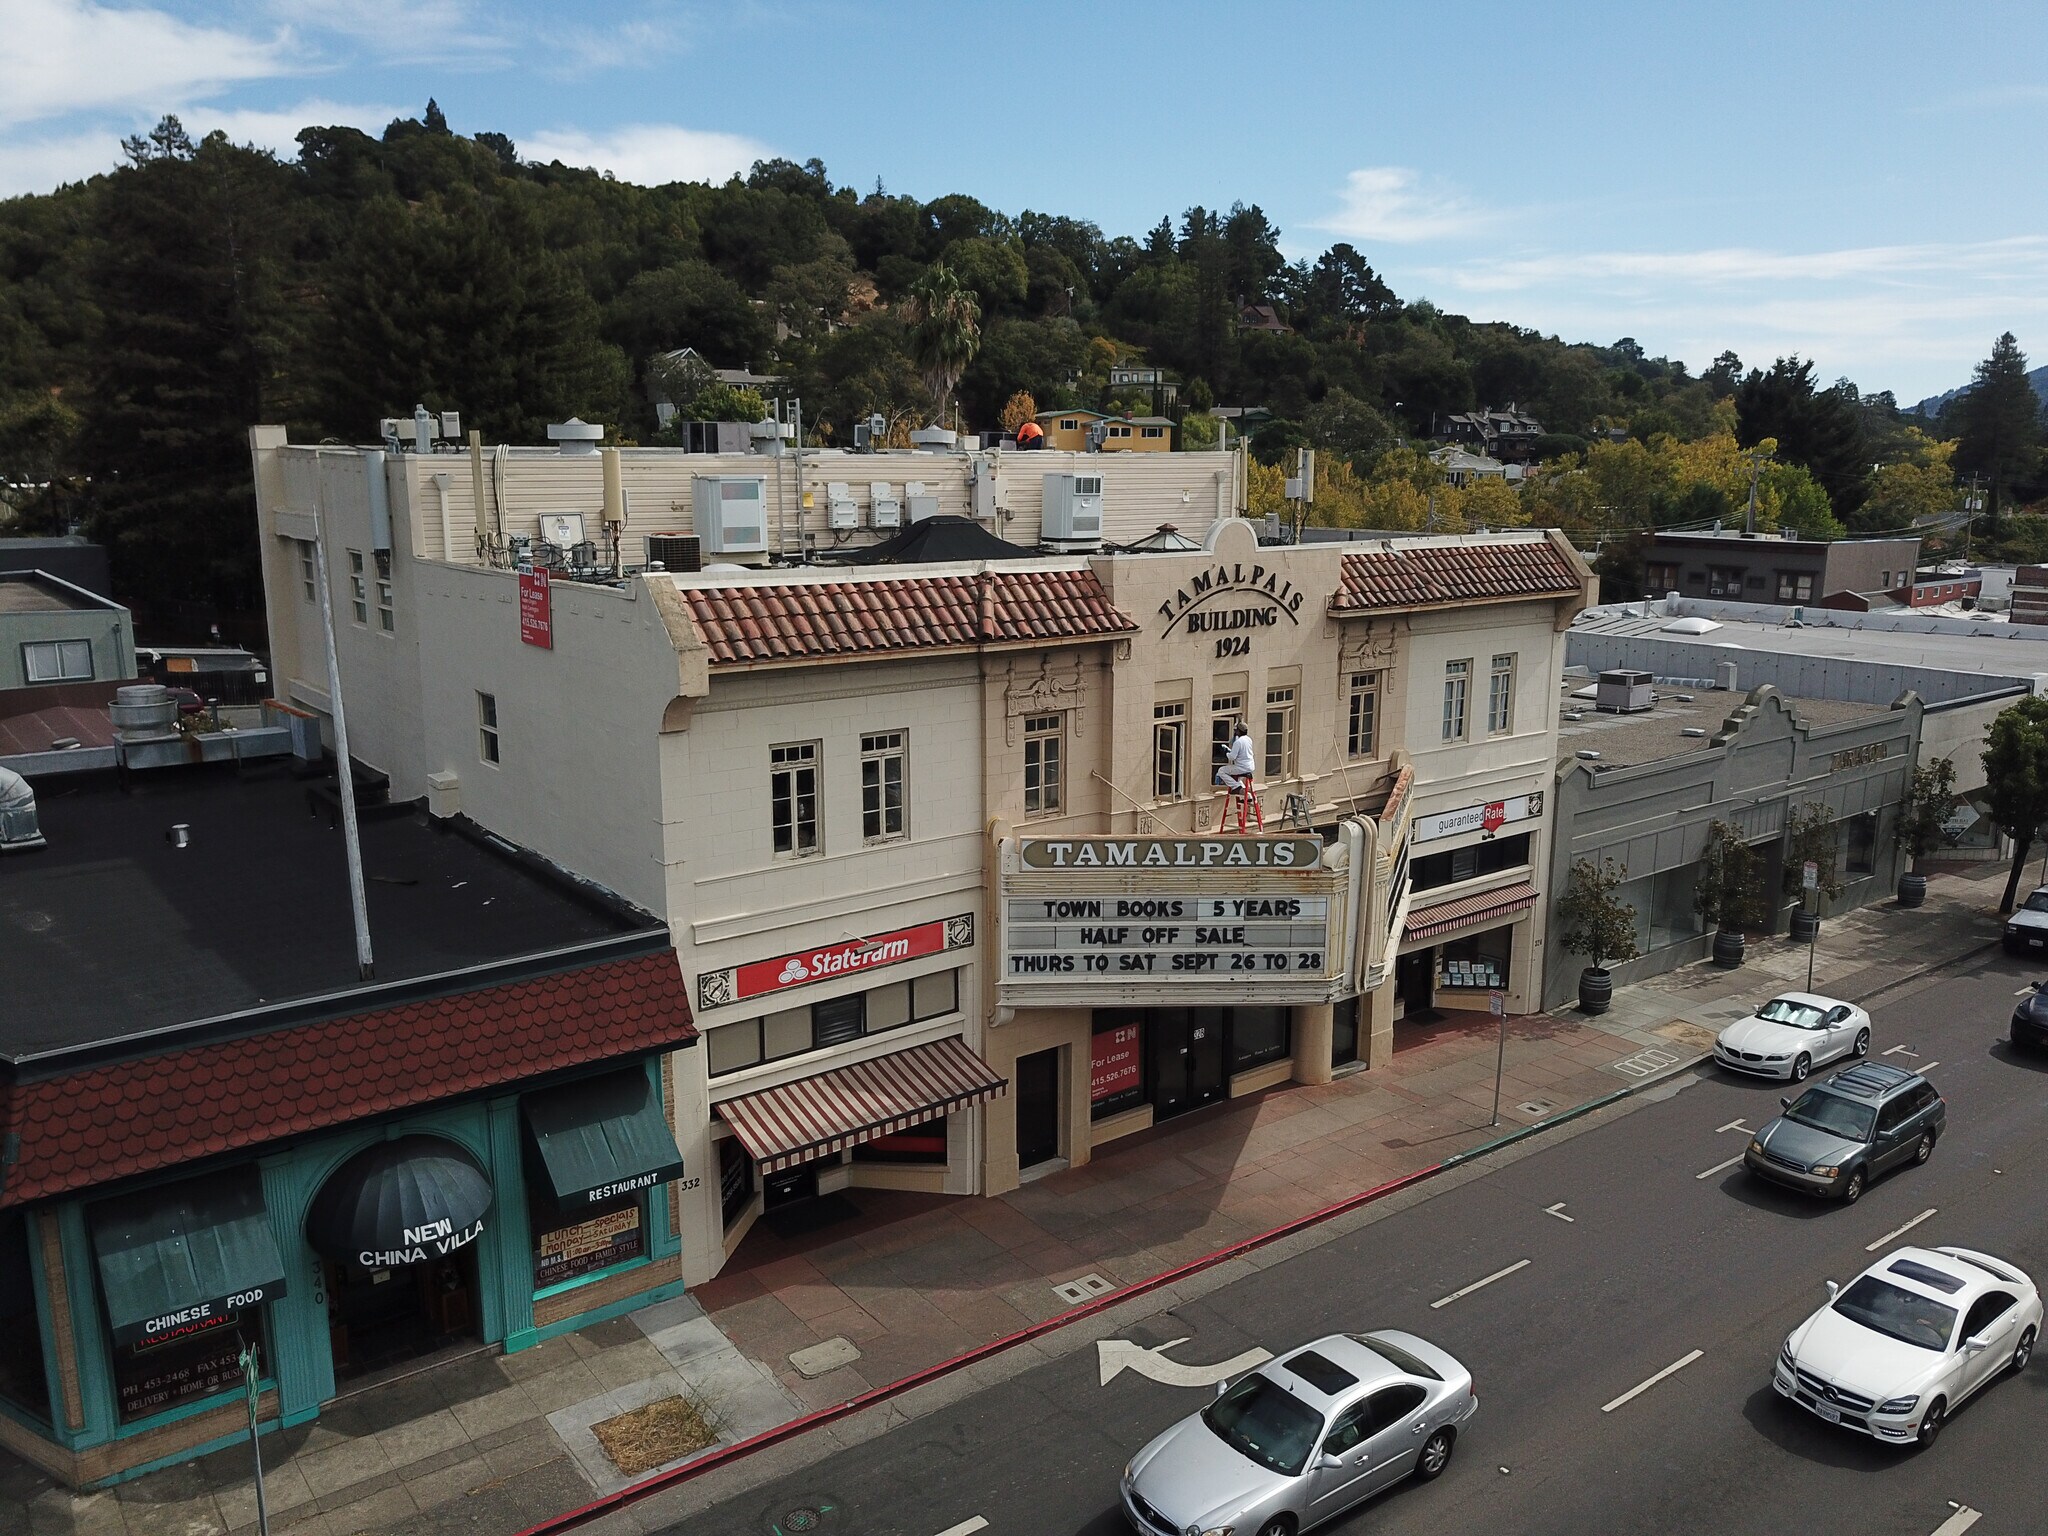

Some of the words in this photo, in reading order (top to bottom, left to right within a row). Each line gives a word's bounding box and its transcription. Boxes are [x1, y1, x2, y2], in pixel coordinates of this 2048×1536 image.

[1159, 563, 1304, 621] TAMALPAIS
[1187, 606, 1277, 633] BUILDING
[1215, 636, 1250, 658] 1924
[1438, 811, 1484, 834] guaranteed
[1485, 807, 1504, 821] Rate
[1046, 842, 1296, 867] TAMALPAIS
[1043, 900, 1101, 918] TOWN
[1116, 900, 1183, 917] BOOKS
[1213, 900, 1225, 917] 5
[1232, 899, 1301, 917] YEARS
[1080, 927, 1128, 944] HALF
[1142, 927, 1179, 944] OFF
[1195, 926, 1244, 944] SALE
[1012, 955, 1075, 972] THURS
[1083, 955, 1109, 971] TO
[1119, 954, 1156, 970] SAT
[1172, 953, 1219, 970] SEPT
[1231, 953, 1256, 970] 26
[1263, 953, 1287, 970] TO
[1298, 952, 1321, 969] 28
[1091, 1058, 1105, 1069] For
[1106, 1050, 1130, 1065] Lease
[1091, 1064, 1137, 1087] 415.526.7676
[588, 1172, 658, 1202] RESTAURANT
[681, 1177, 700, 1192] 332
[359, 1247, 427, 1266] CHINA
[436, 1219, 484, 1255] VILLA
[403, 1217, 452, 1246] NEW
[540, 1261, 569, 1279] CHINESE
[570, 1256, 588, 1270] FOOD
[595, 1245, 619, 1261] FAMILY
[619, 1239, 639, 1252] STYLE
[145, 1303, 211, 1333] CHINESE
[226, 1289, 263, 1309] FOOD
[144, 1367, 190, 1390] 453-2468
[197, 1360, 218, 1374] FAX
[127, 1389, 169, 1412] DELIVERY
[180, 1379, 205, 1395] HOME
[207, 1374, 220, 1386] OR
